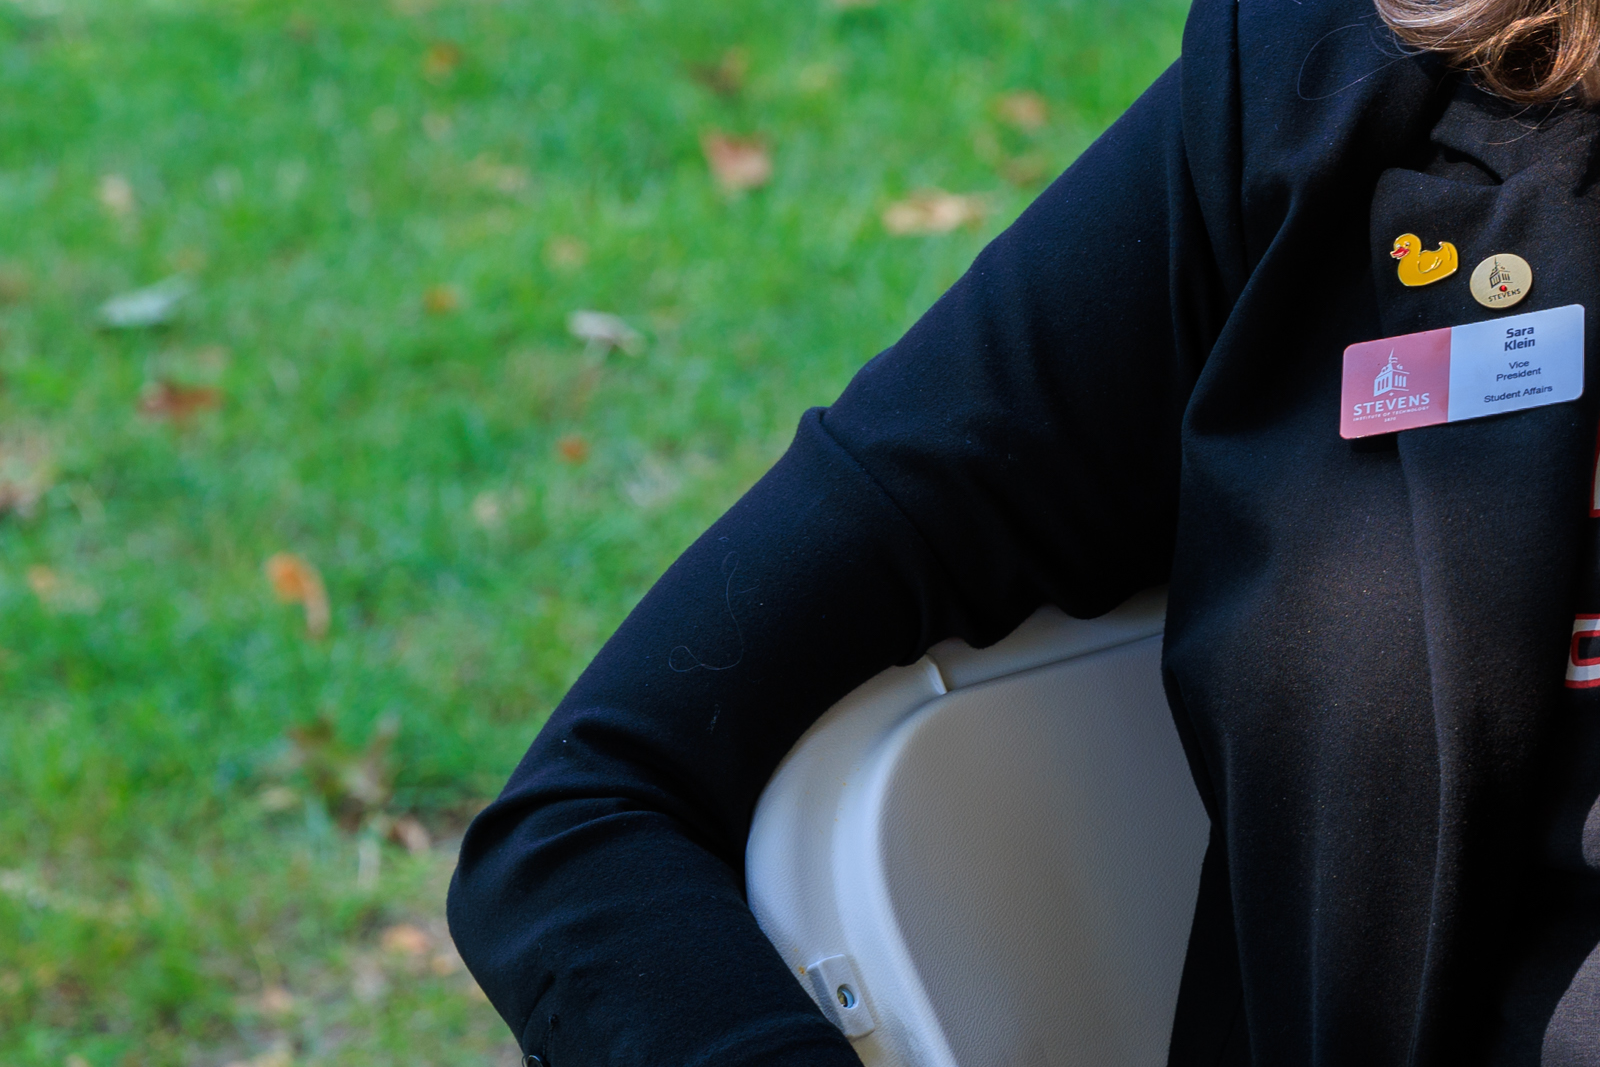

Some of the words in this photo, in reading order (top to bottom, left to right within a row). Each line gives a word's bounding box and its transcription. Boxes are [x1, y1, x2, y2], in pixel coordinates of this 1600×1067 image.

[1488, 288, 1521, 302] STEVENS
[1506, 326, 1535, 339] Sara
[1504, 337, 1536, 352] Klein
[1508, 360, 1530, 370] Vice
[1496, 367, 1542, 382] President
[1483, 390, 1521, 403] Student
[1522, 385, 1554, 397] Affairs
[1353, 392, 1431, 416] STEVENS
